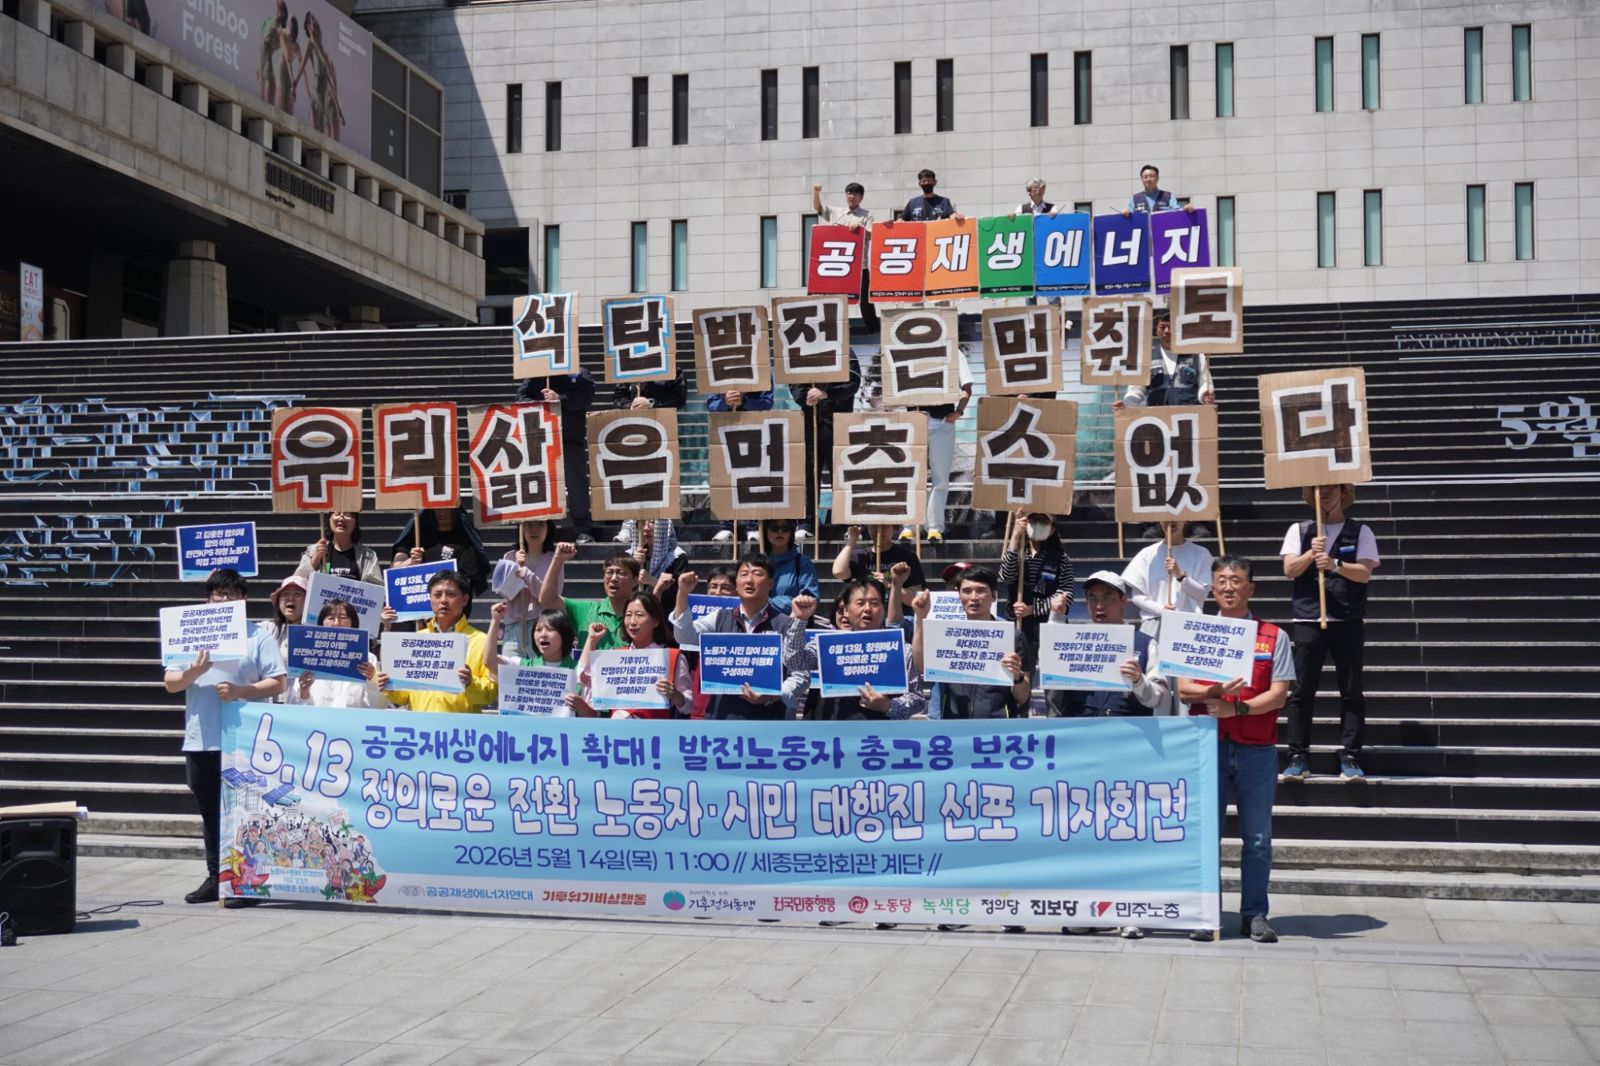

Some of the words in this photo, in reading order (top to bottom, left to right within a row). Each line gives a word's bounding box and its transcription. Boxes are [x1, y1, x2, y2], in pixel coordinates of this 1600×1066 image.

[186, 0, 248, 39] mboo
[183, 9, 239, 71] Forest
[24, 269, 38, 289] EAT
[185, 548, 214, 559] 한전KPS
[229, 545, 250, 555] 노동자
[691, 604, 706, 614] 6월
[945, 627, 1004, 639] 공공재생에너지
[1183, 620, 1246, 636] 공공재생에너지
[1075, 632, 1109, 642] 기후위기,
[1194, 633, 1229, 646] 확대하고
[401, 639, 454, 648] 공공재생에너지
[828, 644, 844, 655] 6월
[844, 643, 864, 654] 13일,
[955, 639, 990, 649] 확대하고
[1053, 642, 1093, 652] 전쟁위기로
[1094, 643, 1127, 653] 심화되는
[292, 647, 324, 657] 한전KPS
[341, 651, 363, 660] 노동자
[411, 649, 441, 658] 확대하고
[935, 649, 978, 660] 발전노동자
[979, 651, 1004, 661] 총고용
[1172, 642, 1216, 656] 발전노동자
[1217, 648, 1244, 660] 총고용
[393, 659, 431, 669] 발전노동자
[432, 660, 455, 669] 총고용
[619, 656, 650, 665] 기후위기,
[704, 657, 734, 666] 정의로운
[735, 657, 750, 666] 전환
[836, 654, 869, 666] 정의로운
[870, 652, 888, 663] 전환
[1058, 653, 1083, 663] 차별과
[1084, 653, 1116, 663] 불평등을
[1184, 655, 1224, 669] 보장하라!
[600, 666, 636, 675] 전쟁위기로
[637, 666, 667, 675] 심화되는
[949, 661, 986, 672] 보장하라!
[1068, 663, 1104, 673] 철폐하라!
[405, 670, 439, 680] 보장하라!
[605, 676, 628, 685] 차별과
[361, 725, 570, 767] 공공재생에너지
[581, 732, 661, 770] 확대!
[678, 734, 845, 771] 발전노동자
[856, 734, 954, 771] 총고용
[971, 733, 1056, 771] 보장!
[250, 712, 354, 798] 6.13
[361, 768, 496, 833] 정의로운
[508, 775, 580, 836] 전환
[811, 779, 925, 843] 대행진
[939, 779, 1018, 842] 선포
[1030, 778, 1188, 843] 기자회견
[454, 844, 533, 869] 2026년
[537, 846, 571, 869] 5월
[576, 847, 658, 872] 14일(목)
[664, 851, 730, 873] 11:00
[751, 852, 877, 875] 세종문화회관
[881, 852, 925, 876] 계단
[425, 886, 534, 901] 공공재생에너지연대
[542, 889, 647, 906] 기후위기비상행동
[688, 896, 756, 912] 기후정의동맹
[773, 894, 836, 913] 전국민중행동
[873, 898, 912, 913] 노동당
[922, 897, 971, 915] 녹색당
[981, 898, 1020, 915] 정의당
[1030, 899, 1079, 917] 진보당
[1115, 901, 1180, 919] 민주노총
